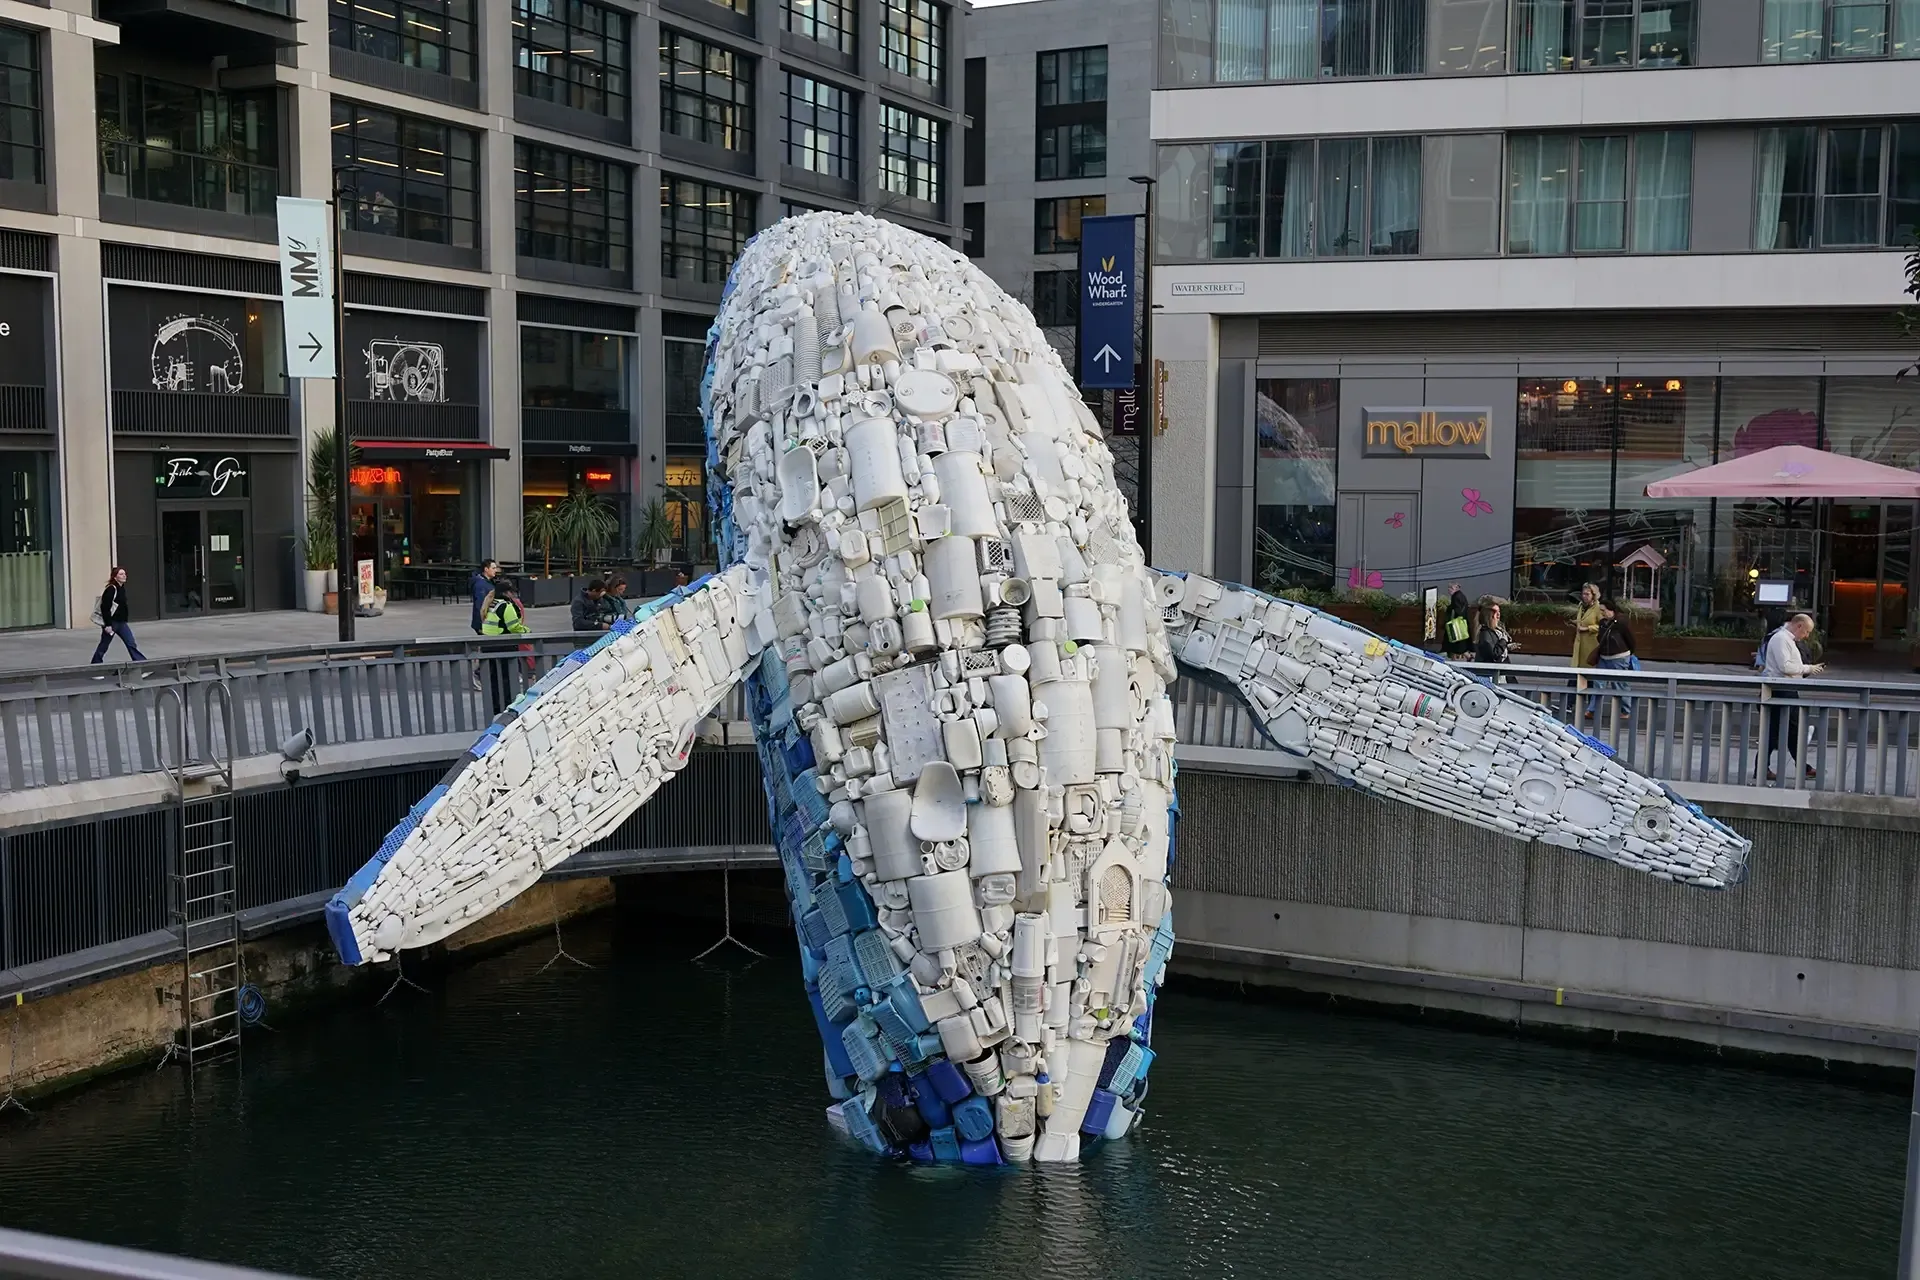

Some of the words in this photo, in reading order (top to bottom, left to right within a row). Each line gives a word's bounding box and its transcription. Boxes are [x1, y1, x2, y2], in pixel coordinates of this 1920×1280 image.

[1088, 270, 1123, 285] Wood
[1088, 284, 1128, 299] Wharf.
[1203, 284, 1234, 292] STREET
[1366, 411, 1487, 455] mallow
[1524, 626, 1533, 635] in
[1534, 628, 1565, 636] season
